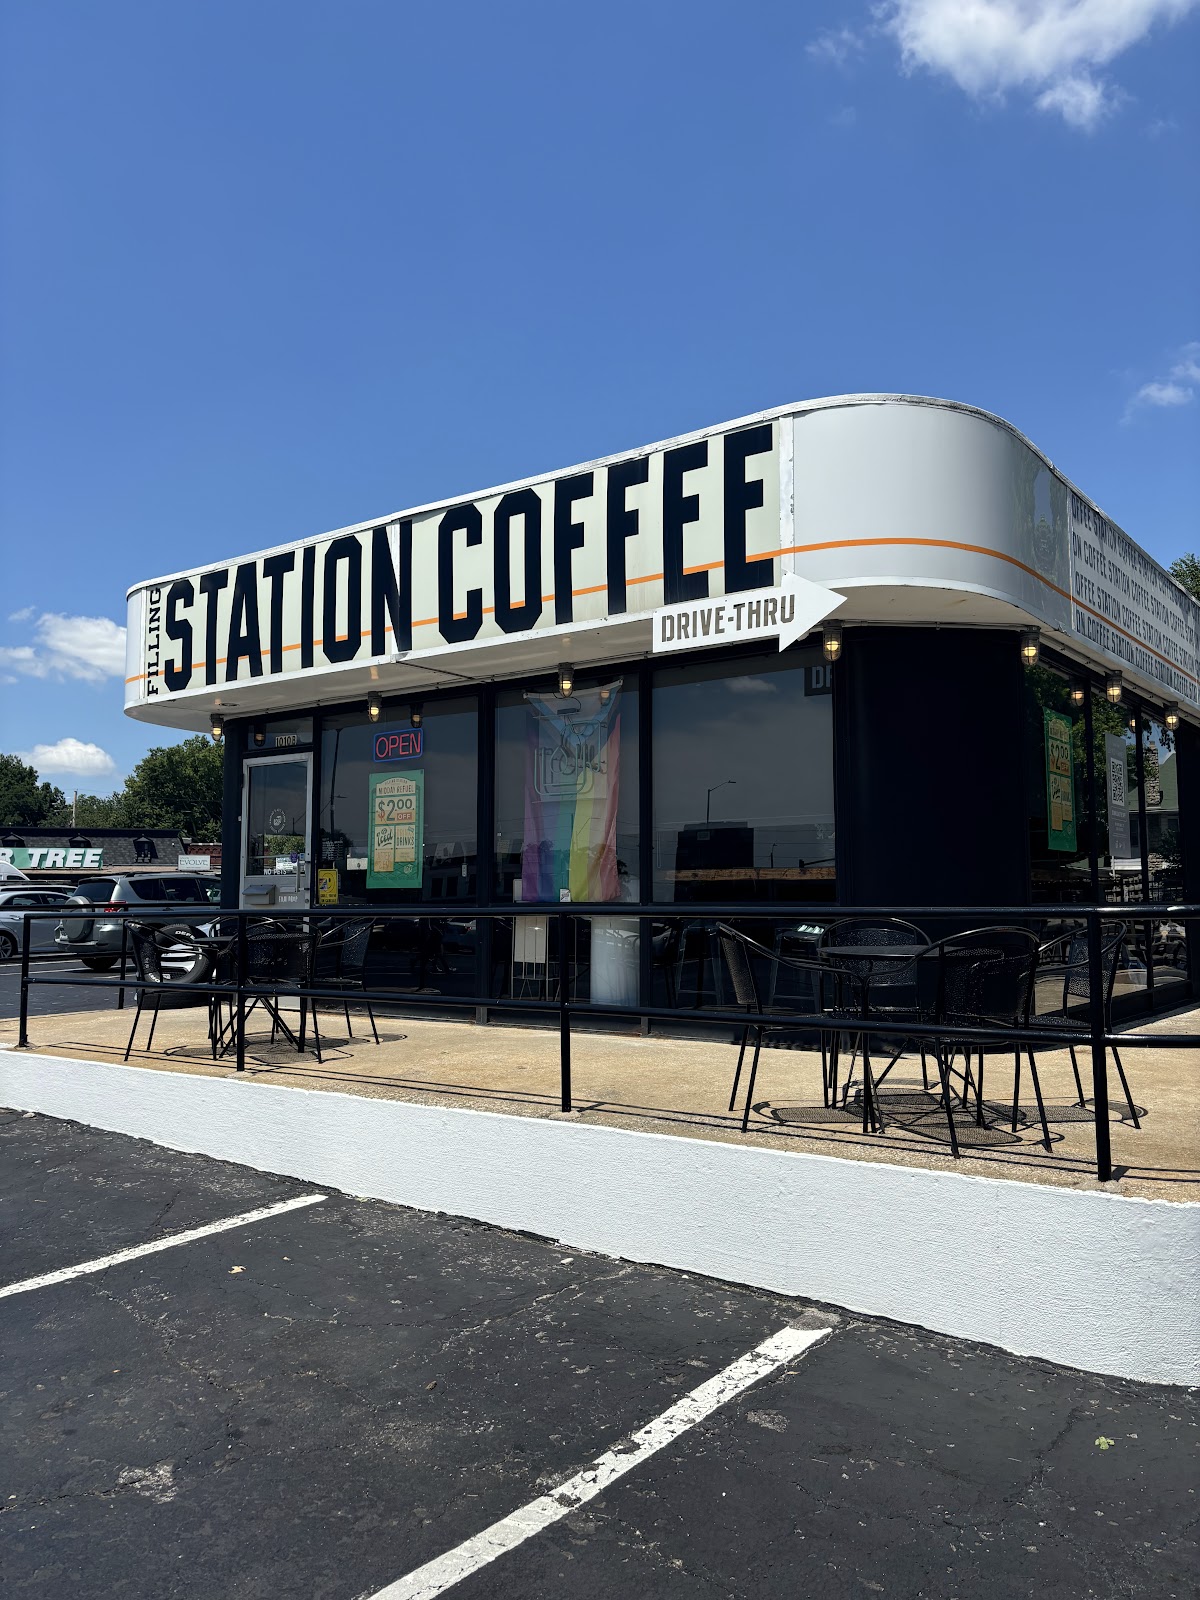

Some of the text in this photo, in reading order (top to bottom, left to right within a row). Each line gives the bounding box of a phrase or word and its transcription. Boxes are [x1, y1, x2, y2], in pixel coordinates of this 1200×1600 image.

[164, 423, 774, 692] STATION COFFEE
[1084, 540, 1107, 580] COFFEE
[1108, 559, 1130, 600] STATION
[661, 594, 796, 643] DRIVE-THRU
[1075, 571, 1095, 607] OFFEE
[1097, 586, 1121, 624] STATION
[1122, 604, 1142, 638] COFFEE
[147, 587, 161, 696] FILLING
[1087, 615, 1109, 650] COFFEE
[1112, 631, 1134, 662] STATION
[376, 731, 421, 758] OPEN
[28, 848, 103, 868] TREE
[396, 836, 415, 847] DRINKS
